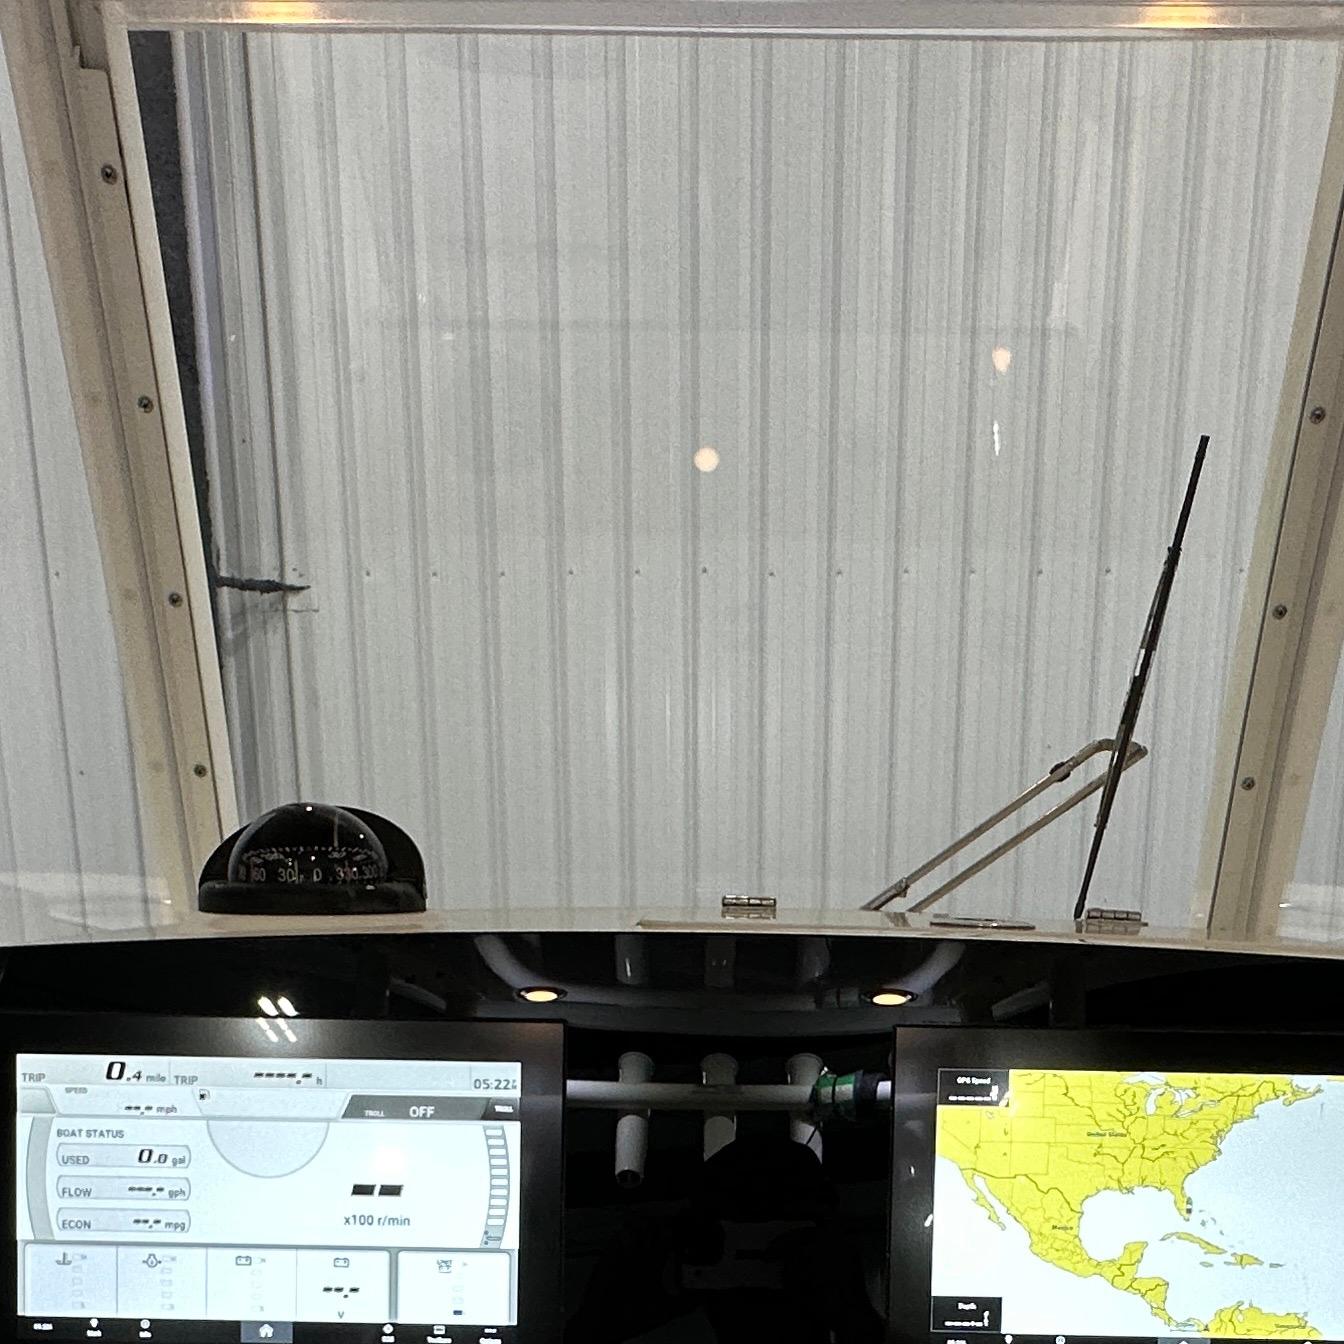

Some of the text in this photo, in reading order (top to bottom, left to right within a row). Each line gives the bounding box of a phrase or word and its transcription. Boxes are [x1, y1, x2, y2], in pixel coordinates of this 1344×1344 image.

[21, 1061, 166, 1083] TRIP 0.4 mile
[174, 1075, 199, 1085] TRIP
[156, 1105, 178, 1114] mph
[409, 1105, 435, 1118] OFF
[56, 1128, 125, 1139] BOAT STATUS
[62, 1155, 90, 1165] USED
[138, 1149, 168, 1164] 0.0
[62, 1187, 185, 1199] FLOW gph
[62, 1219, 185, 1231] ECON mpg
[344, 1215, 410, 1227] x100 r/min
